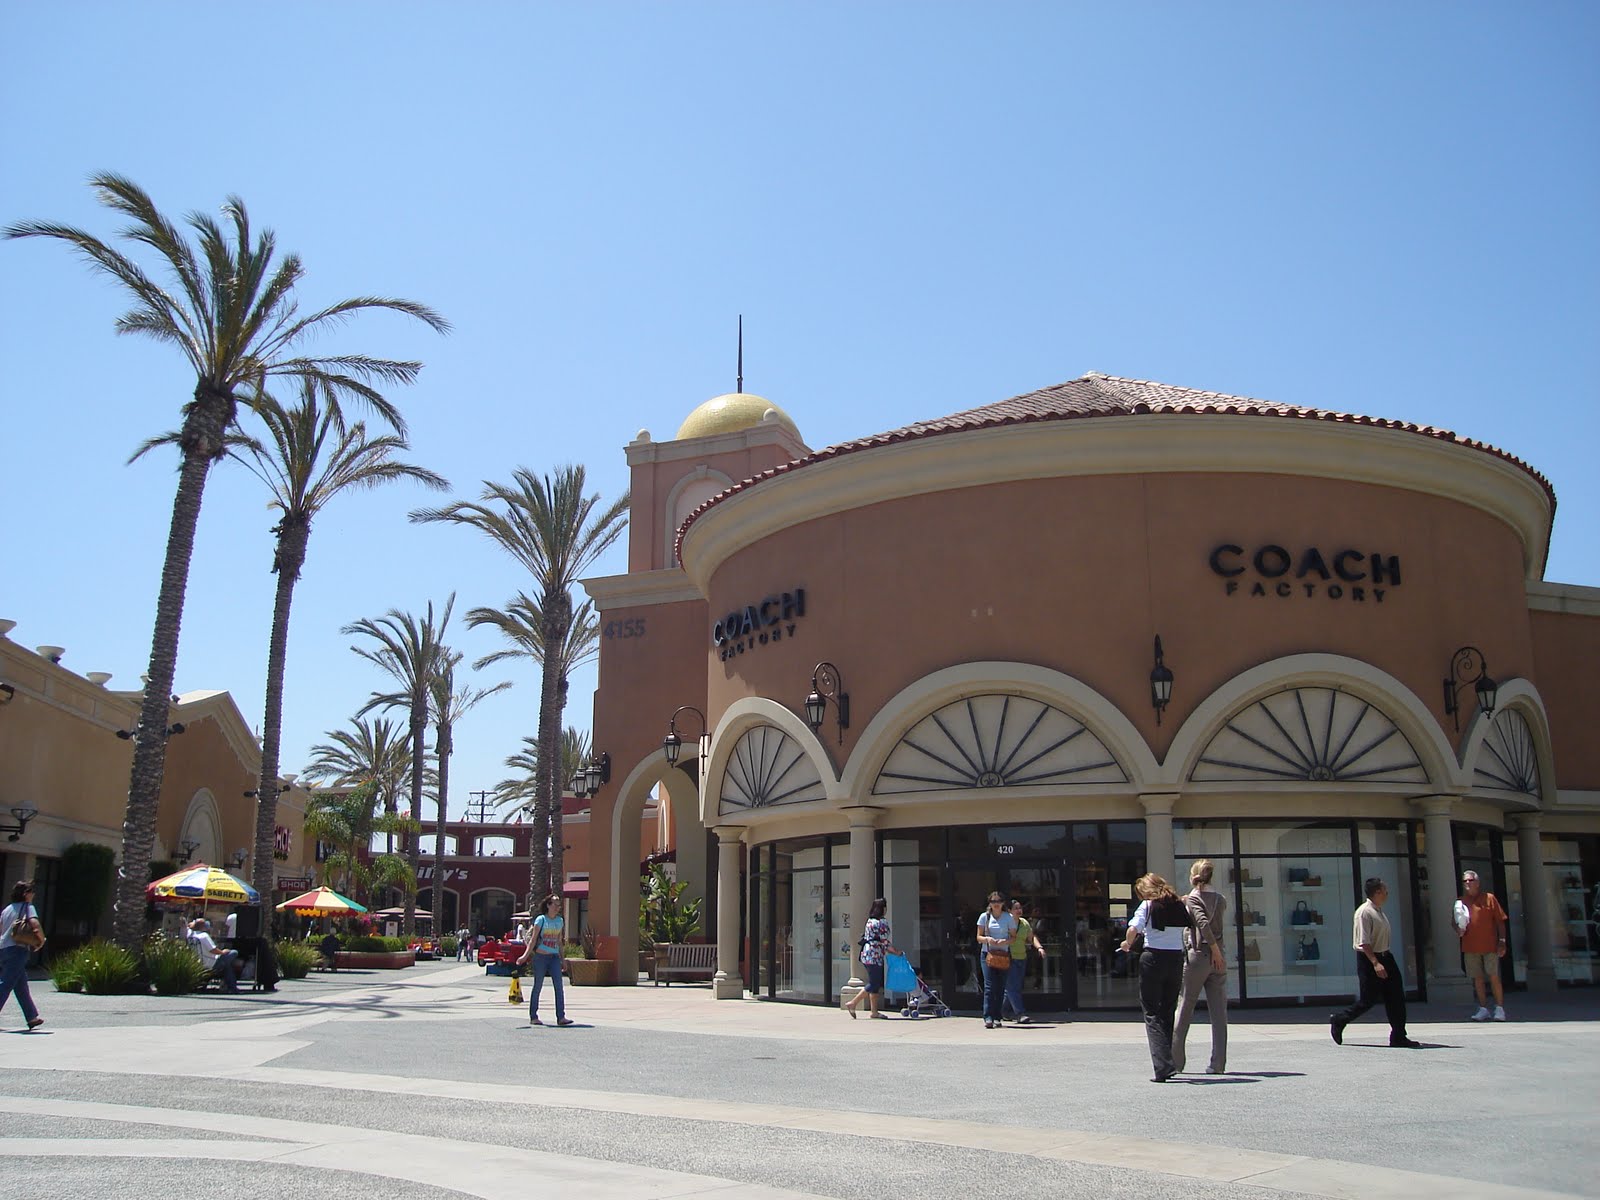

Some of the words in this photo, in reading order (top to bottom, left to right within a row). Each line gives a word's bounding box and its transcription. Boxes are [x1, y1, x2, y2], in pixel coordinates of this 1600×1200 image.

[1209, 544, 1401, 586] COACH
[1226, 581, 1385, 603] FACTORY
[604, 617, 647, 640] 4155
[713, 588, 805, 647] COACH
[721, 623, 796, 662] FACTORY
[997, 845, 1014, 854] 420
[207, 889, 246, 900] SABRETT
[280, 881, 306, 889] SHOE
